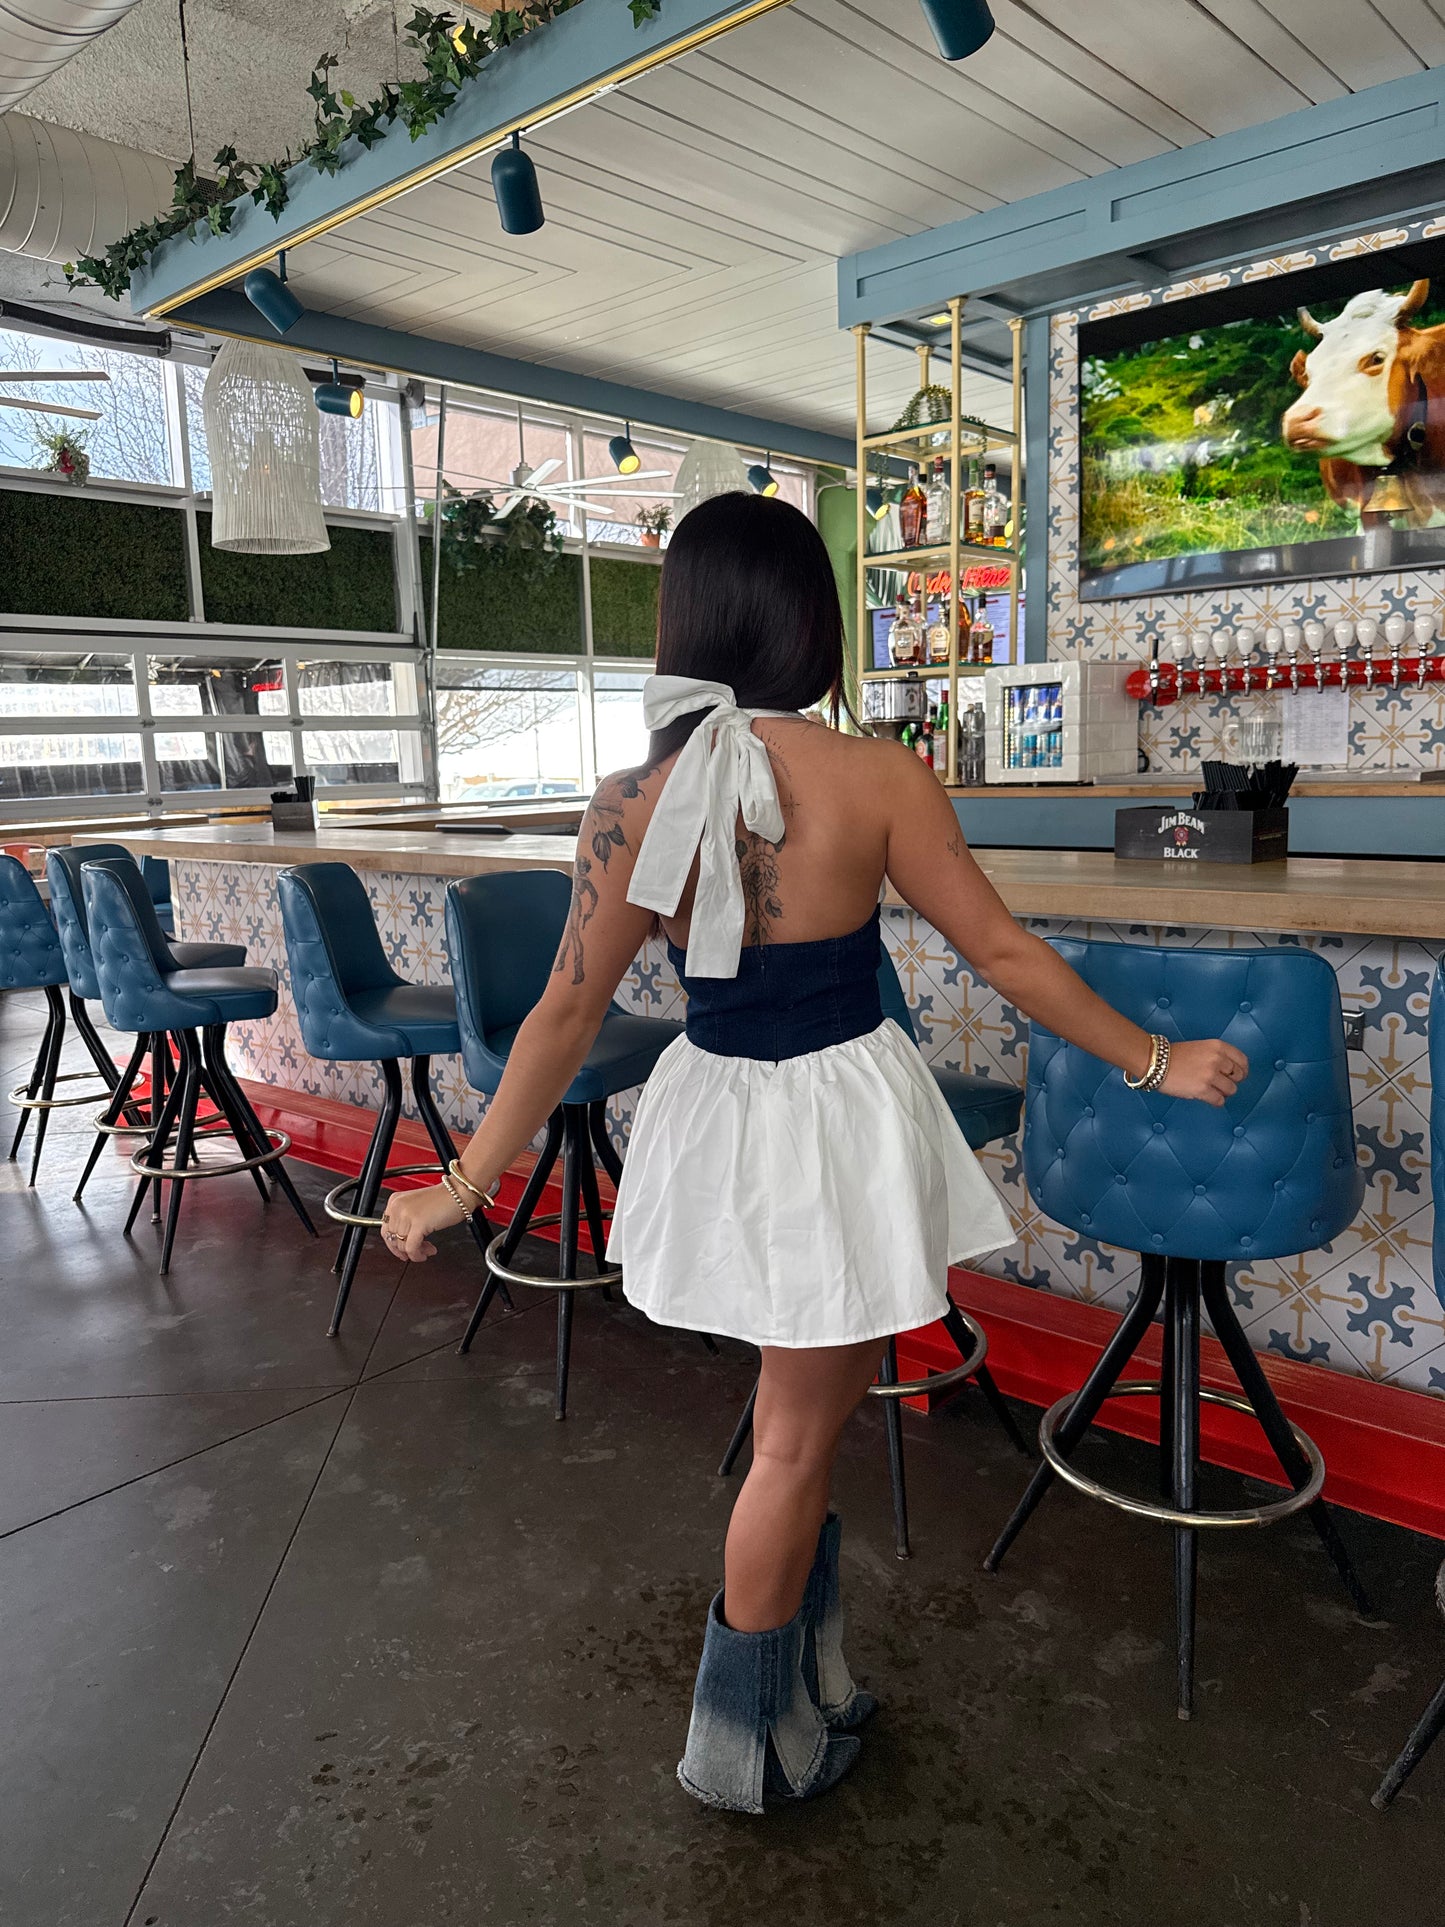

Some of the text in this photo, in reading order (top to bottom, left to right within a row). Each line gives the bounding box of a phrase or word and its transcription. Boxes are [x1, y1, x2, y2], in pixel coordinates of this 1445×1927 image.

[962, 565, 1012, 590] Here
[1158, 812, 1205, 835] JIM BEAM
[1163, 847, 1198, 859] BLACK
